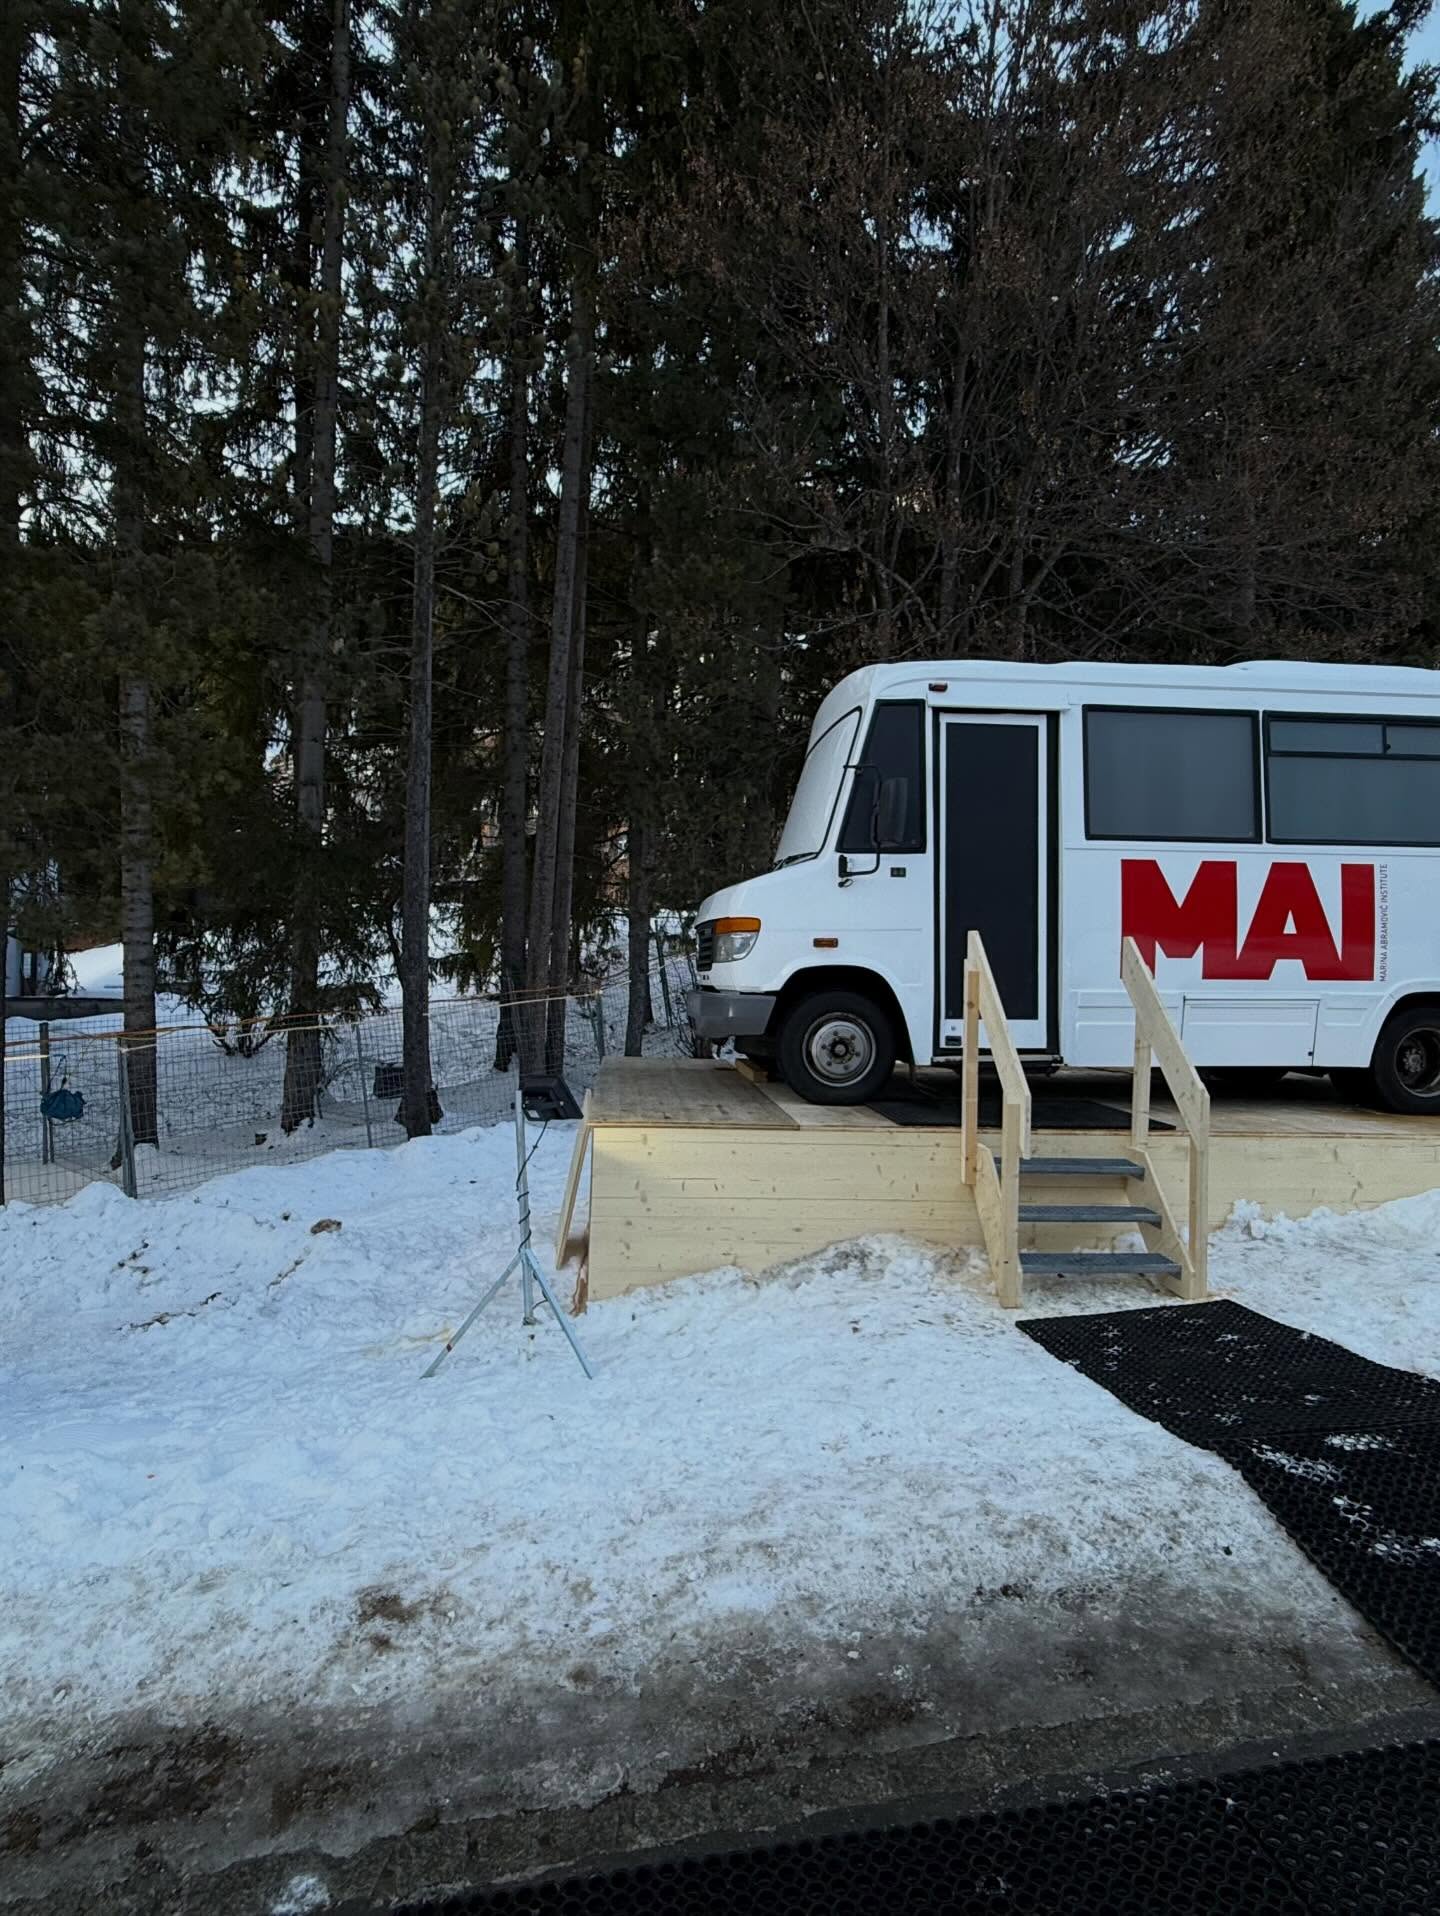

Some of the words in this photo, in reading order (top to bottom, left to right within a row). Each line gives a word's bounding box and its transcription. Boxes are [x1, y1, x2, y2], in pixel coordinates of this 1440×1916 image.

[1379, 863, 1388, 903] INSTITUTE
[1121, 859, 1374, 980] MAI
[1379, 951, 1387, 982] MARINA
